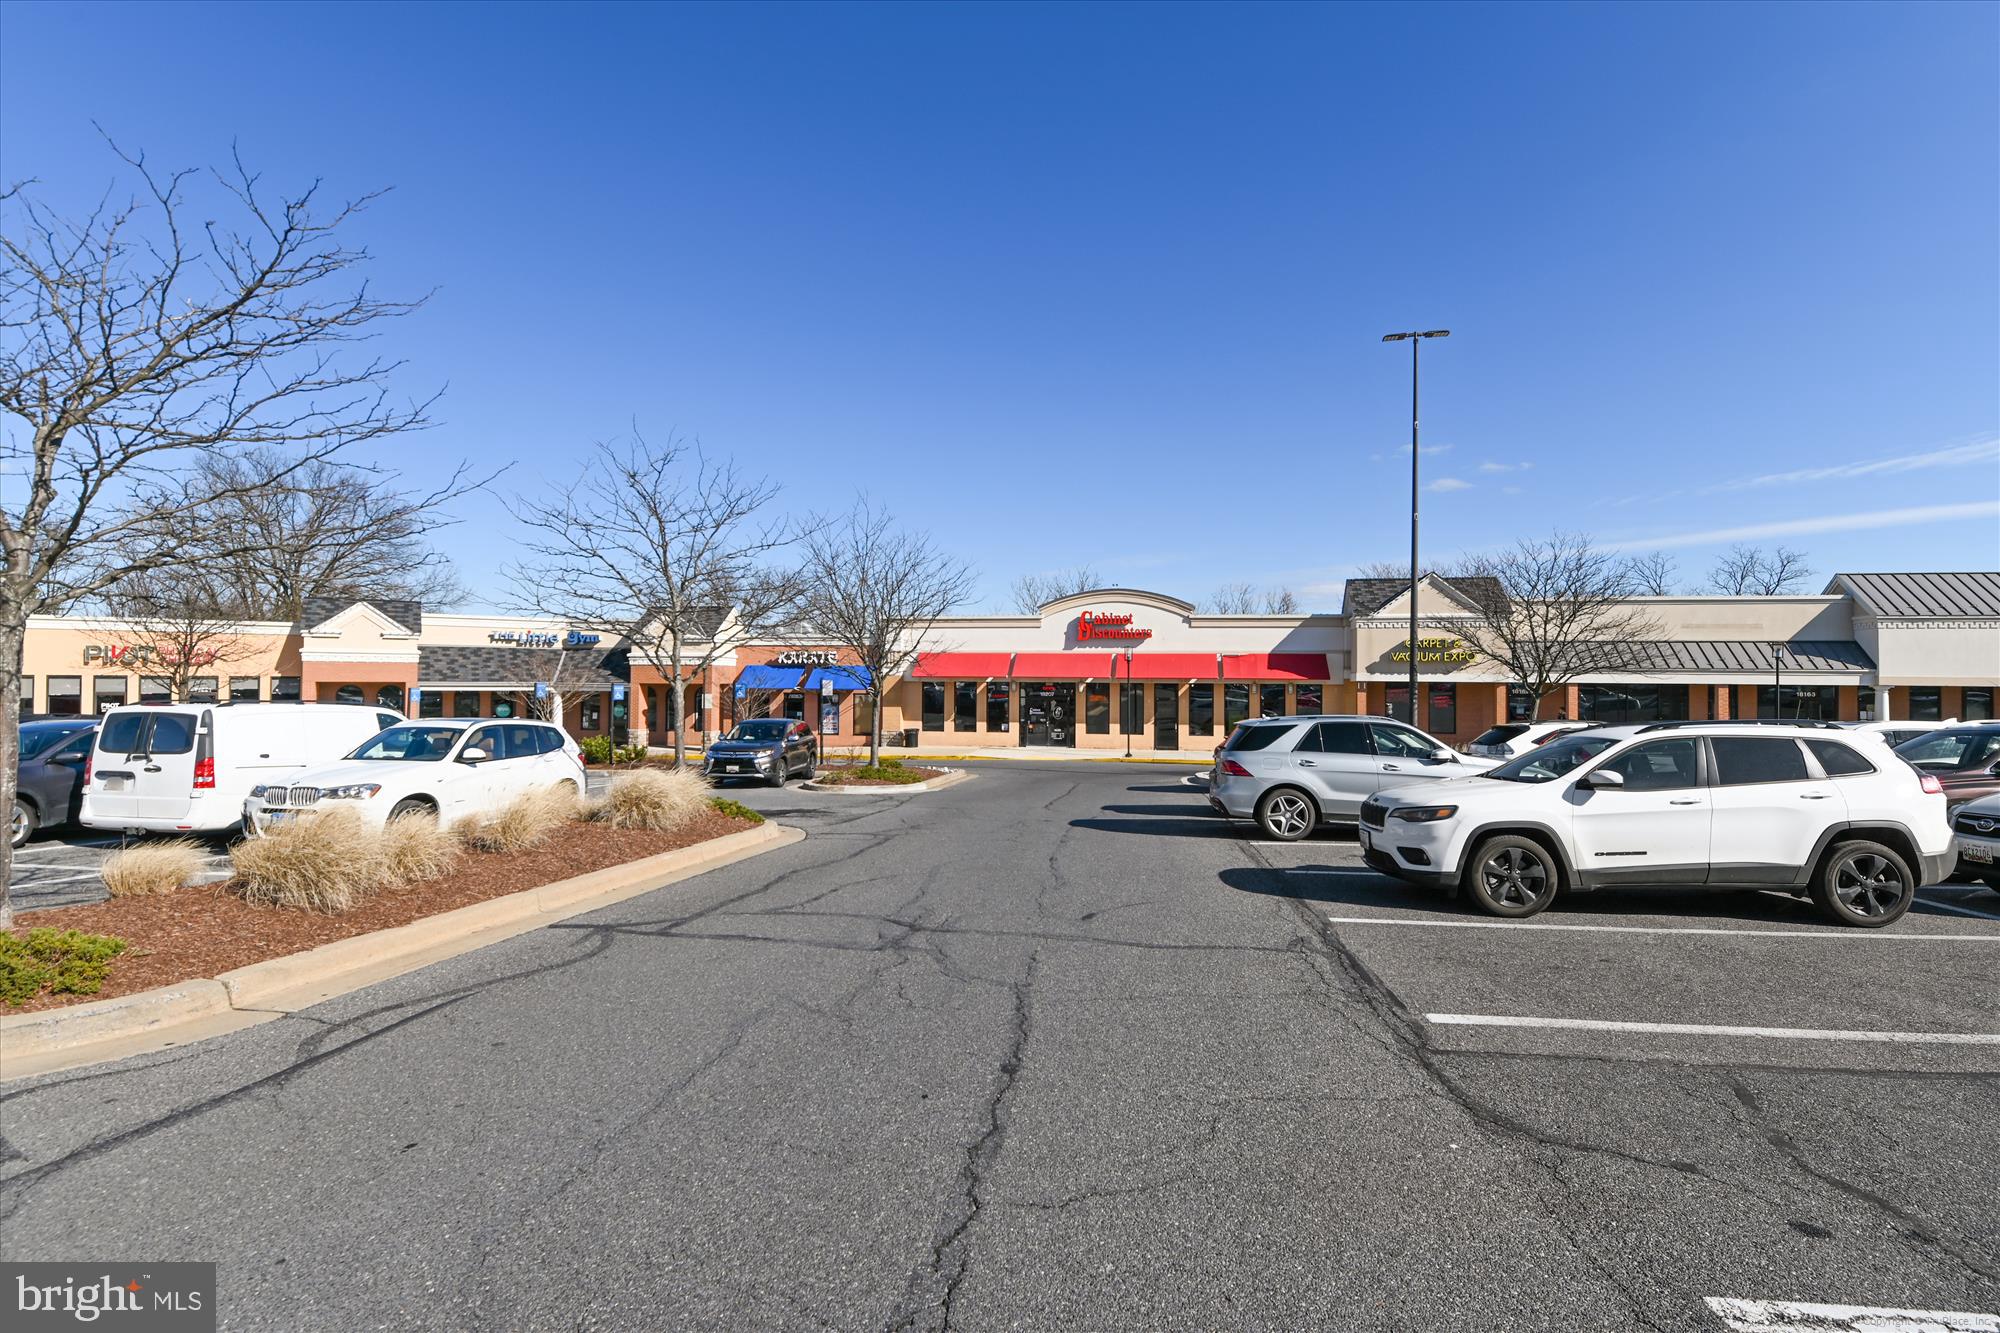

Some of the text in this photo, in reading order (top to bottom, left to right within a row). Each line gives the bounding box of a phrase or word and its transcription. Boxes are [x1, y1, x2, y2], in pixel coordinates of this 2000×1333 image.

[1080, 611, 1133, 631] Cabinet
[1078, 622, 1152, 640] Discounters
[778, 651, 838, 664] KARATE
[1444, 652, 1477, 662] EXPO
